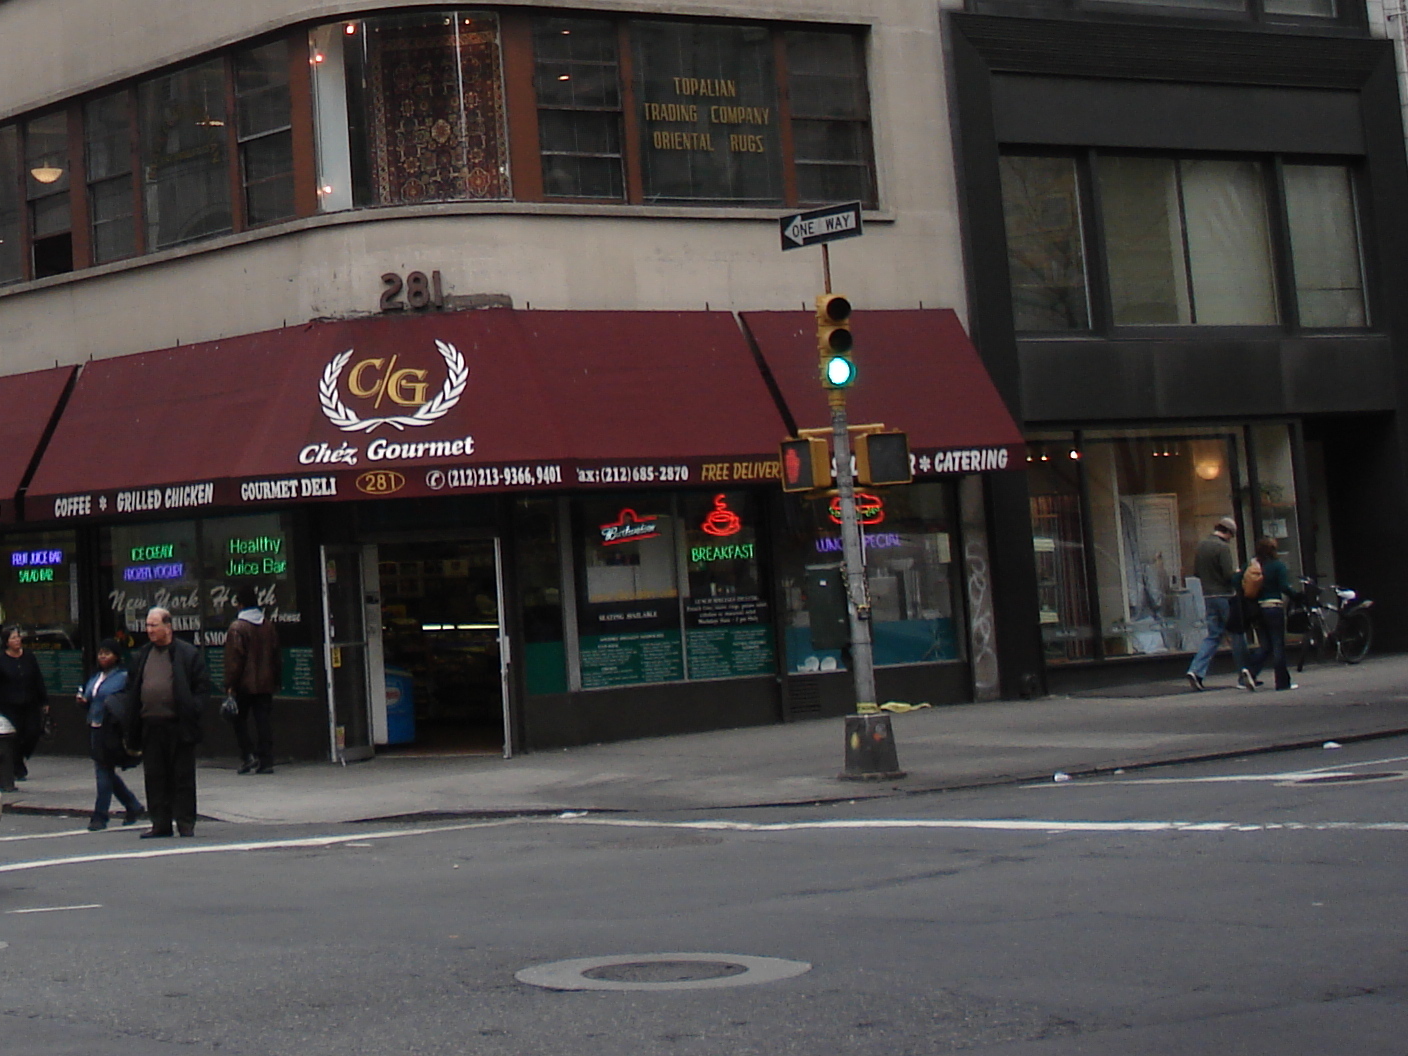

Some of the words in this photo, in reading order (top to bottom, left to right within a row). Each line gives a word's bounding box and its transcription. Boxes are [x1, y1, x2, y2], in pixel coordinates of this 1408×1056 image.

[673, 77, 736, 97] TOPALIAN
[644, 102, 698, 122] TRADING
[710, 105, 770, 125] COMPANY
[653, 131, 715, 152] ORIENTAL
[730, 134, 765, 153] RUGS
[792, 221, 814, 238] ONE
[825, 214, 850, 231] WAY
[379, 270, 443, 311] 281
[366, 435, 475, 461] Gourmet
[701, 462, 730, 481] FREE
[733, 460, 781, 480] DELIVER
[934, 448, 1009, 473] CATERING
[241, 479, 298, 501] GOURMET
[301, 477, 337, 497] DELI
[365, 474, 397, 491] 281
[54, 495, 92, 518] COFFEE
[116, 489, 162, 513] GRILLED
[165, 482, 214, 509] CHICKEN
[229, 536, 282, 555] Healthy
[691, 543, 754, 562] BREAKFAST
[815, 536, 843, 553] LUNC
[862, 533, 903, 548] PECIAL
[30, 551, 48, 564] JUICE
[48, 550, 62, 563] BAR
[131, 546, 145, 562] ICE
[226, 559, 260, 577] Juice
[262, 558, 287, 575] Bar
[109, 589, 148, 611] New
[153, 586, 200, 609] York
